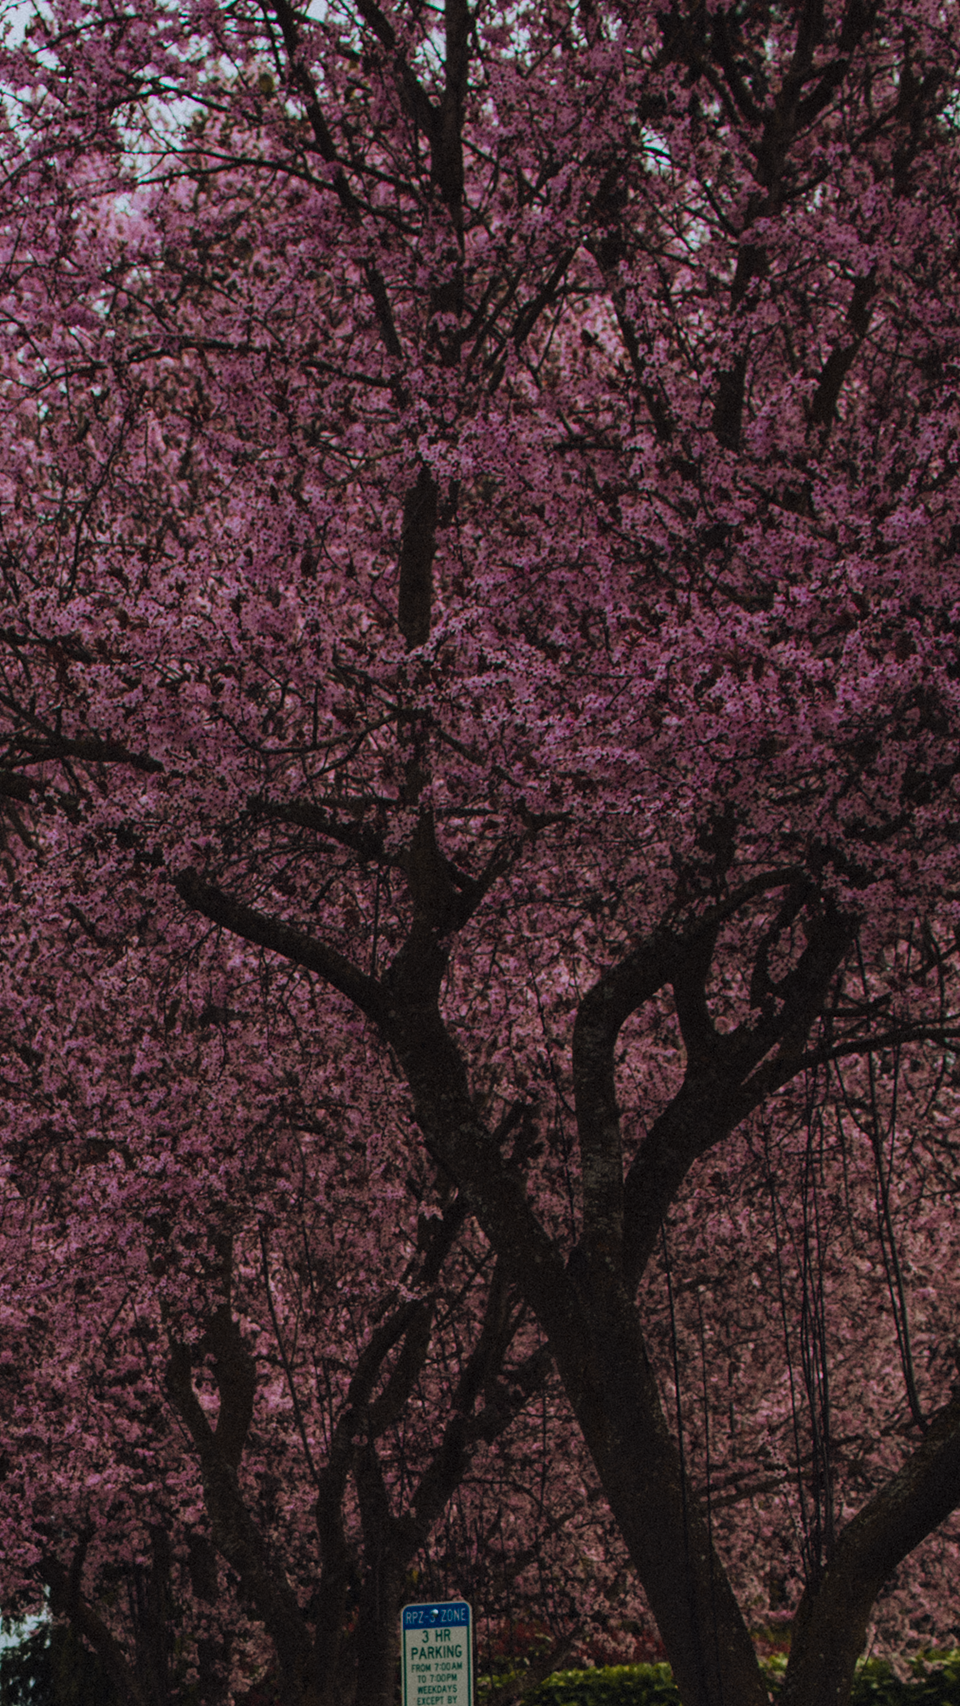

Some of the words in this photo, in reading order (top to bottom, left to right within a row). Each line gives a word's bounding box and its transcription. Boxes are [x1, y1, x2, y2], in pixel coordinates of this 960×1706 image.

[440, 1607, 466, 1622] ZONE
[421, 1629, 429, 1643] 3
[435, 1628, 451, 1642] HR
[411, 1644, 462, 1660] PARKING
[411, 1663, 431, 1673] FROM
[417, 1675, 427, 1683] TO
[417, 1684, 458, 1694] WEEKDAYS
[416, 1696, 444, 1706] EXCEPT
[447, 1695, 458, 1704] BY
